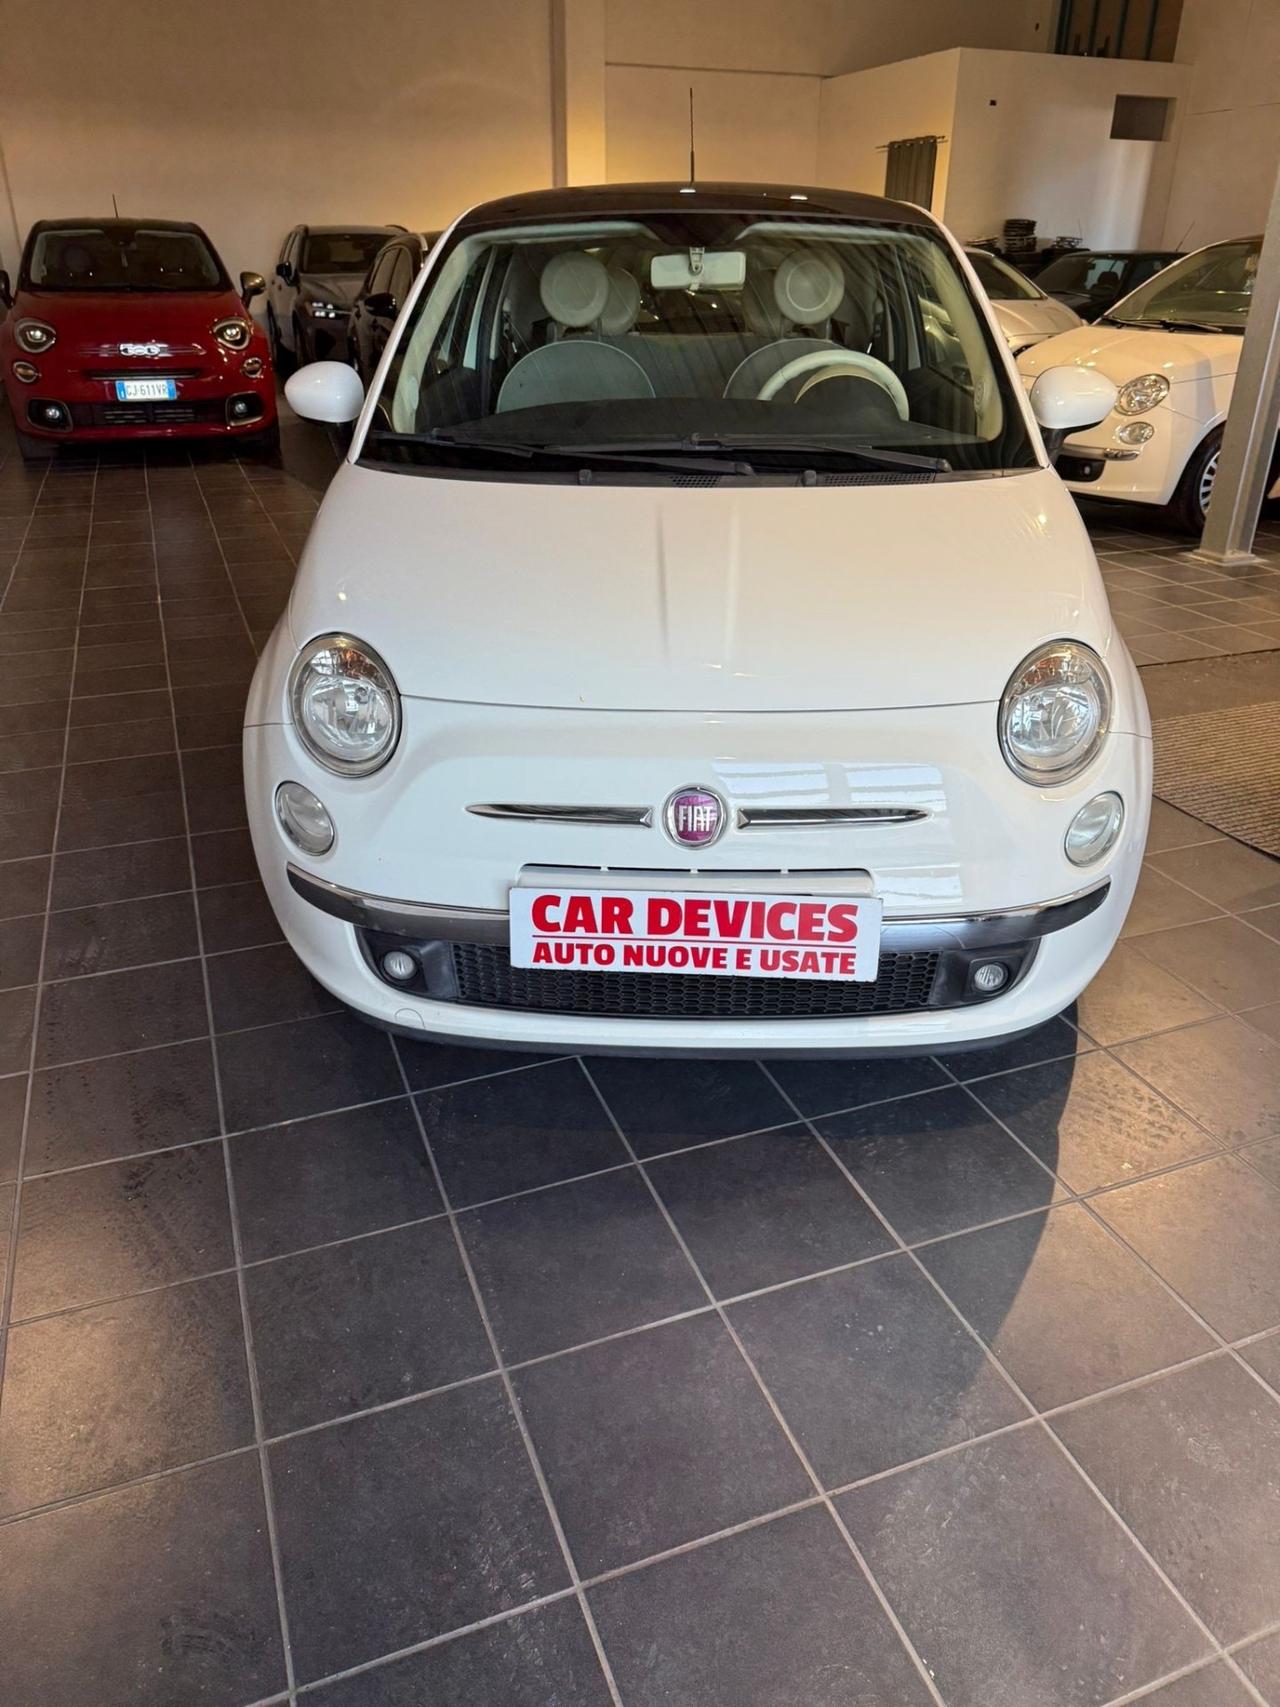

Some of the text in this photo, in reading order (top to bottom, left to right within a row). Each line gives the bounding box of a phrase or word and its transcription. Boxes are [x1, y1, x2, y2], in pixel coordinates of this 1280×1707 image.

[678, 805, 714, 832] FIAT
[531, 894, 859, 943] CAR DEVICES
[532, 942, 857, 975] AUTO NUOVE E USATE
